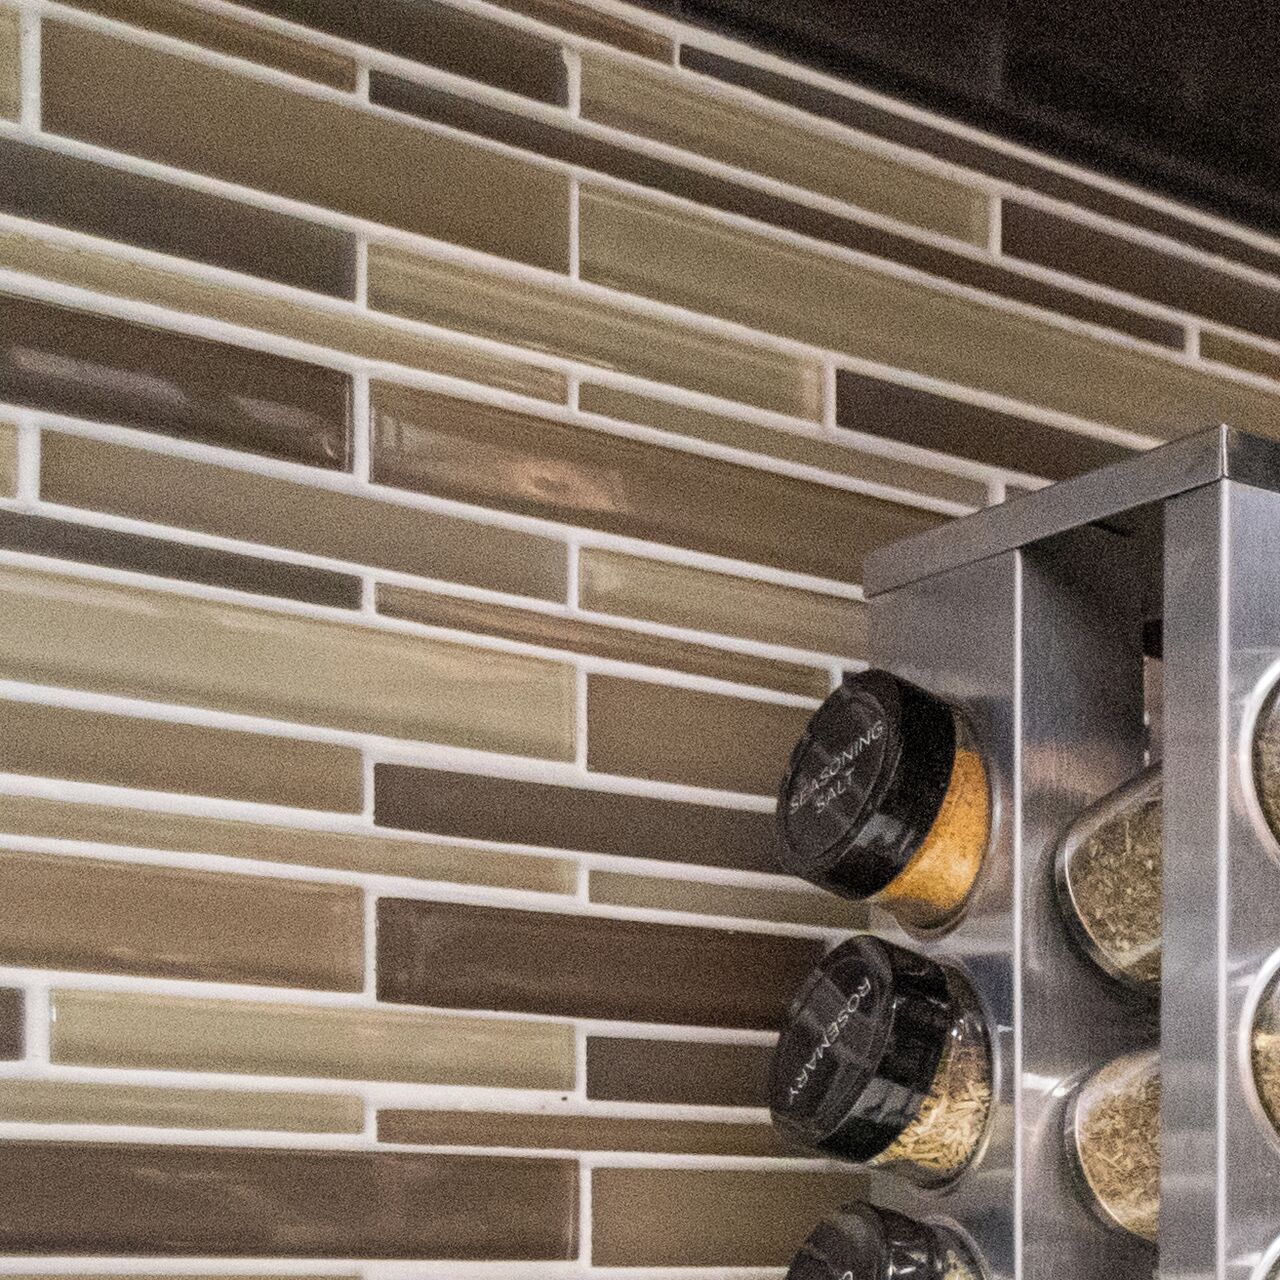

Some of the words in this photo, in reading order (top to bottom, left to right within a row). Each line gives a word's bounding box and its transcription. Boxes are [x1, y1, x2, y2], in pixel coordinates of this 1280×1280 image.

[790, 719, 885, 815] SEASONING
[815, 768, 855, 815] SALT
[788, 977, 873, 1104] ROSEMARY
